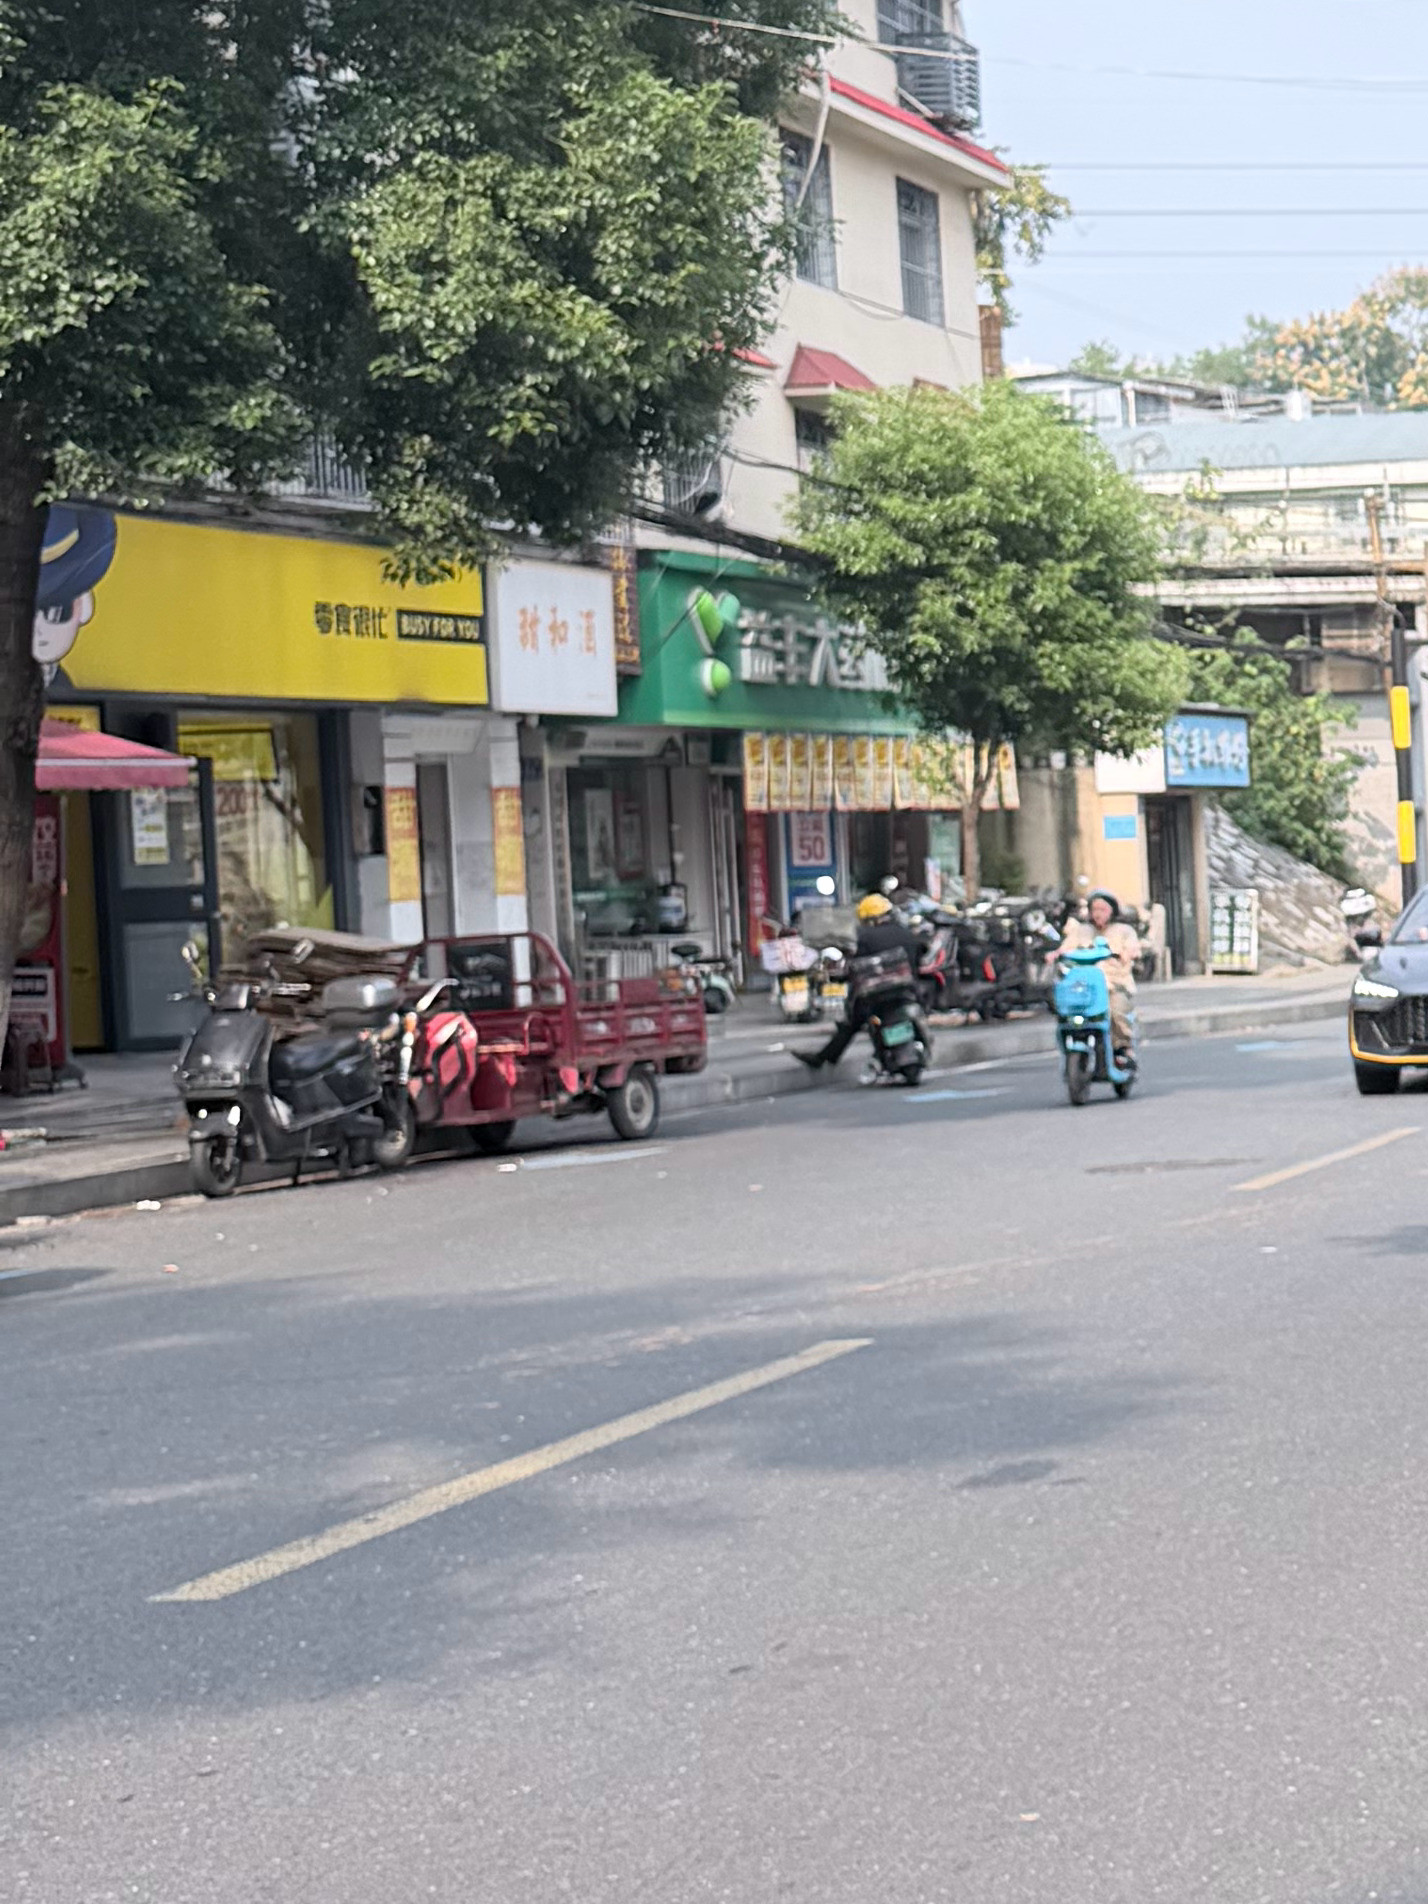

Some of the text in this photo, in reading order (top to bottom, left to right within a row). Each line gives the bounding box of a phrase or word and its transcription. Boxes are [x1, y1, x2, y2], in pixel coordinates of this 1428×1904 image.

[402, 614, 480, 640] BUSY FOR YOU
